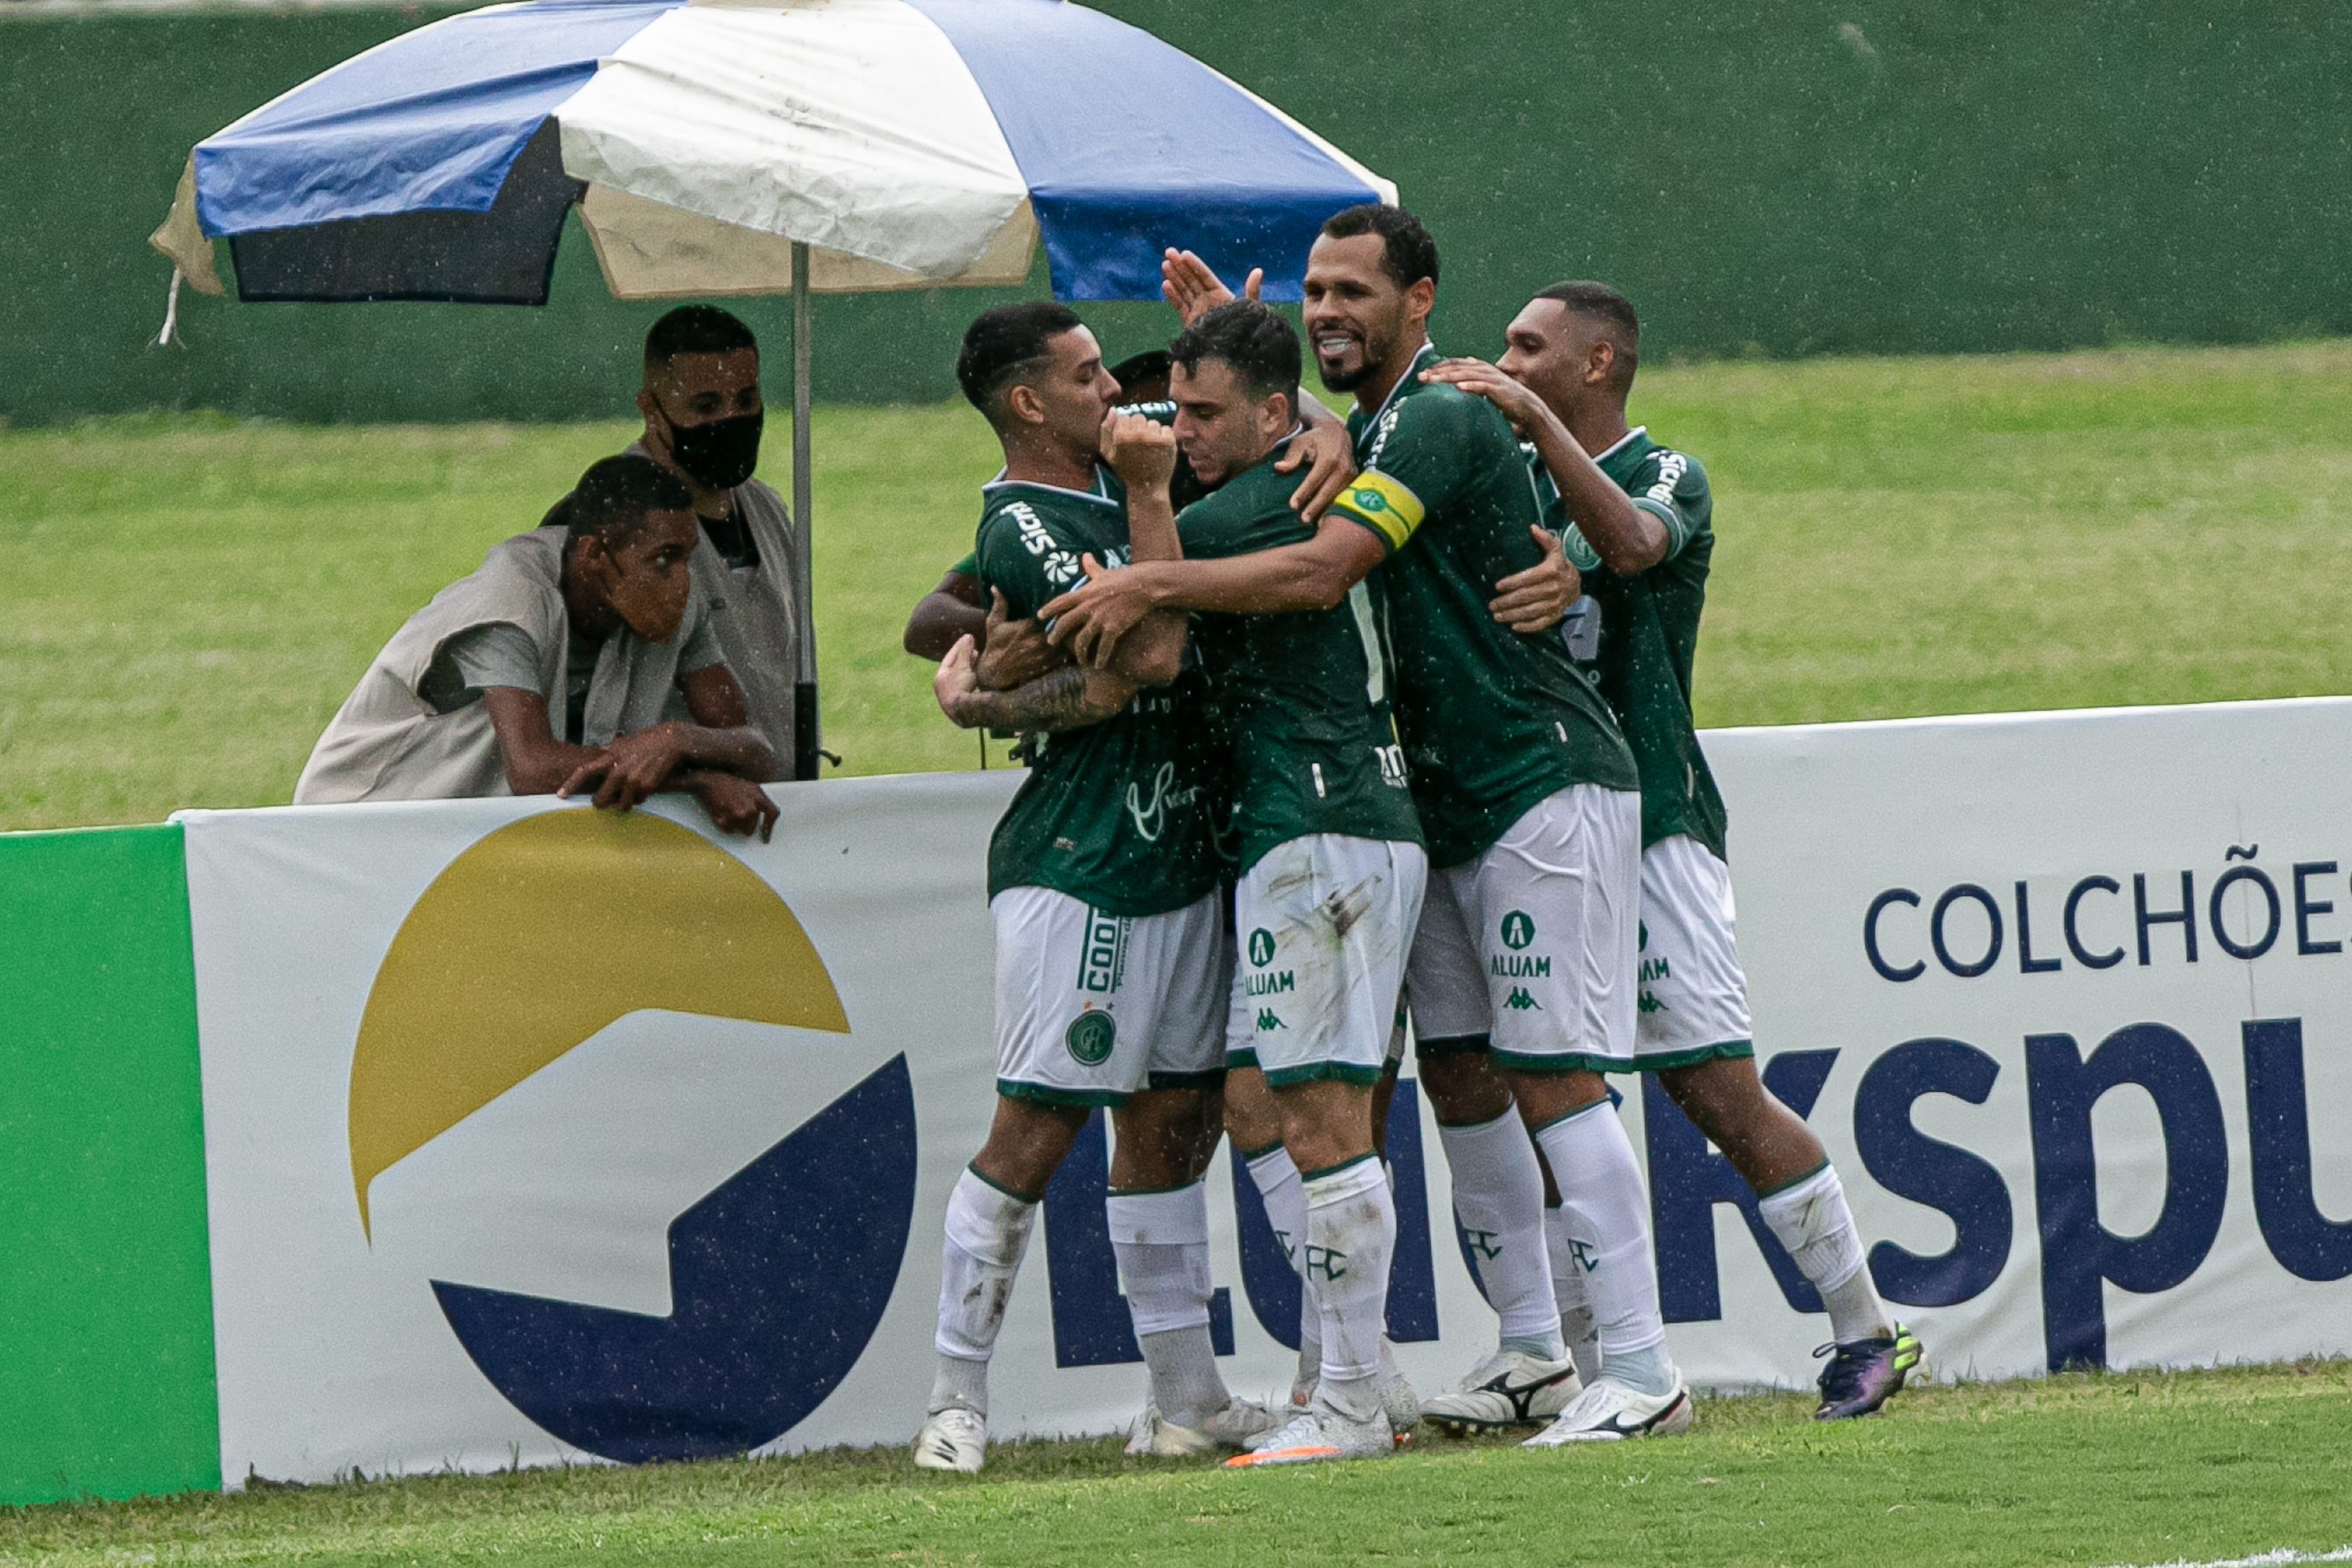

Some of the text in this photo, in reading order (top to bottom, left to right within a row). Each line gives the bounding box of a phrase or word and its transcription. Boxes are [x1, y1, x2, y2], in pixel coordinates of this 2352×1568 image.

[1086, 909, 1117, 993] COO
[1864, 844, 2352, 982] COLCHÕE
[1490, 953, 1552, 978] ALUAM
